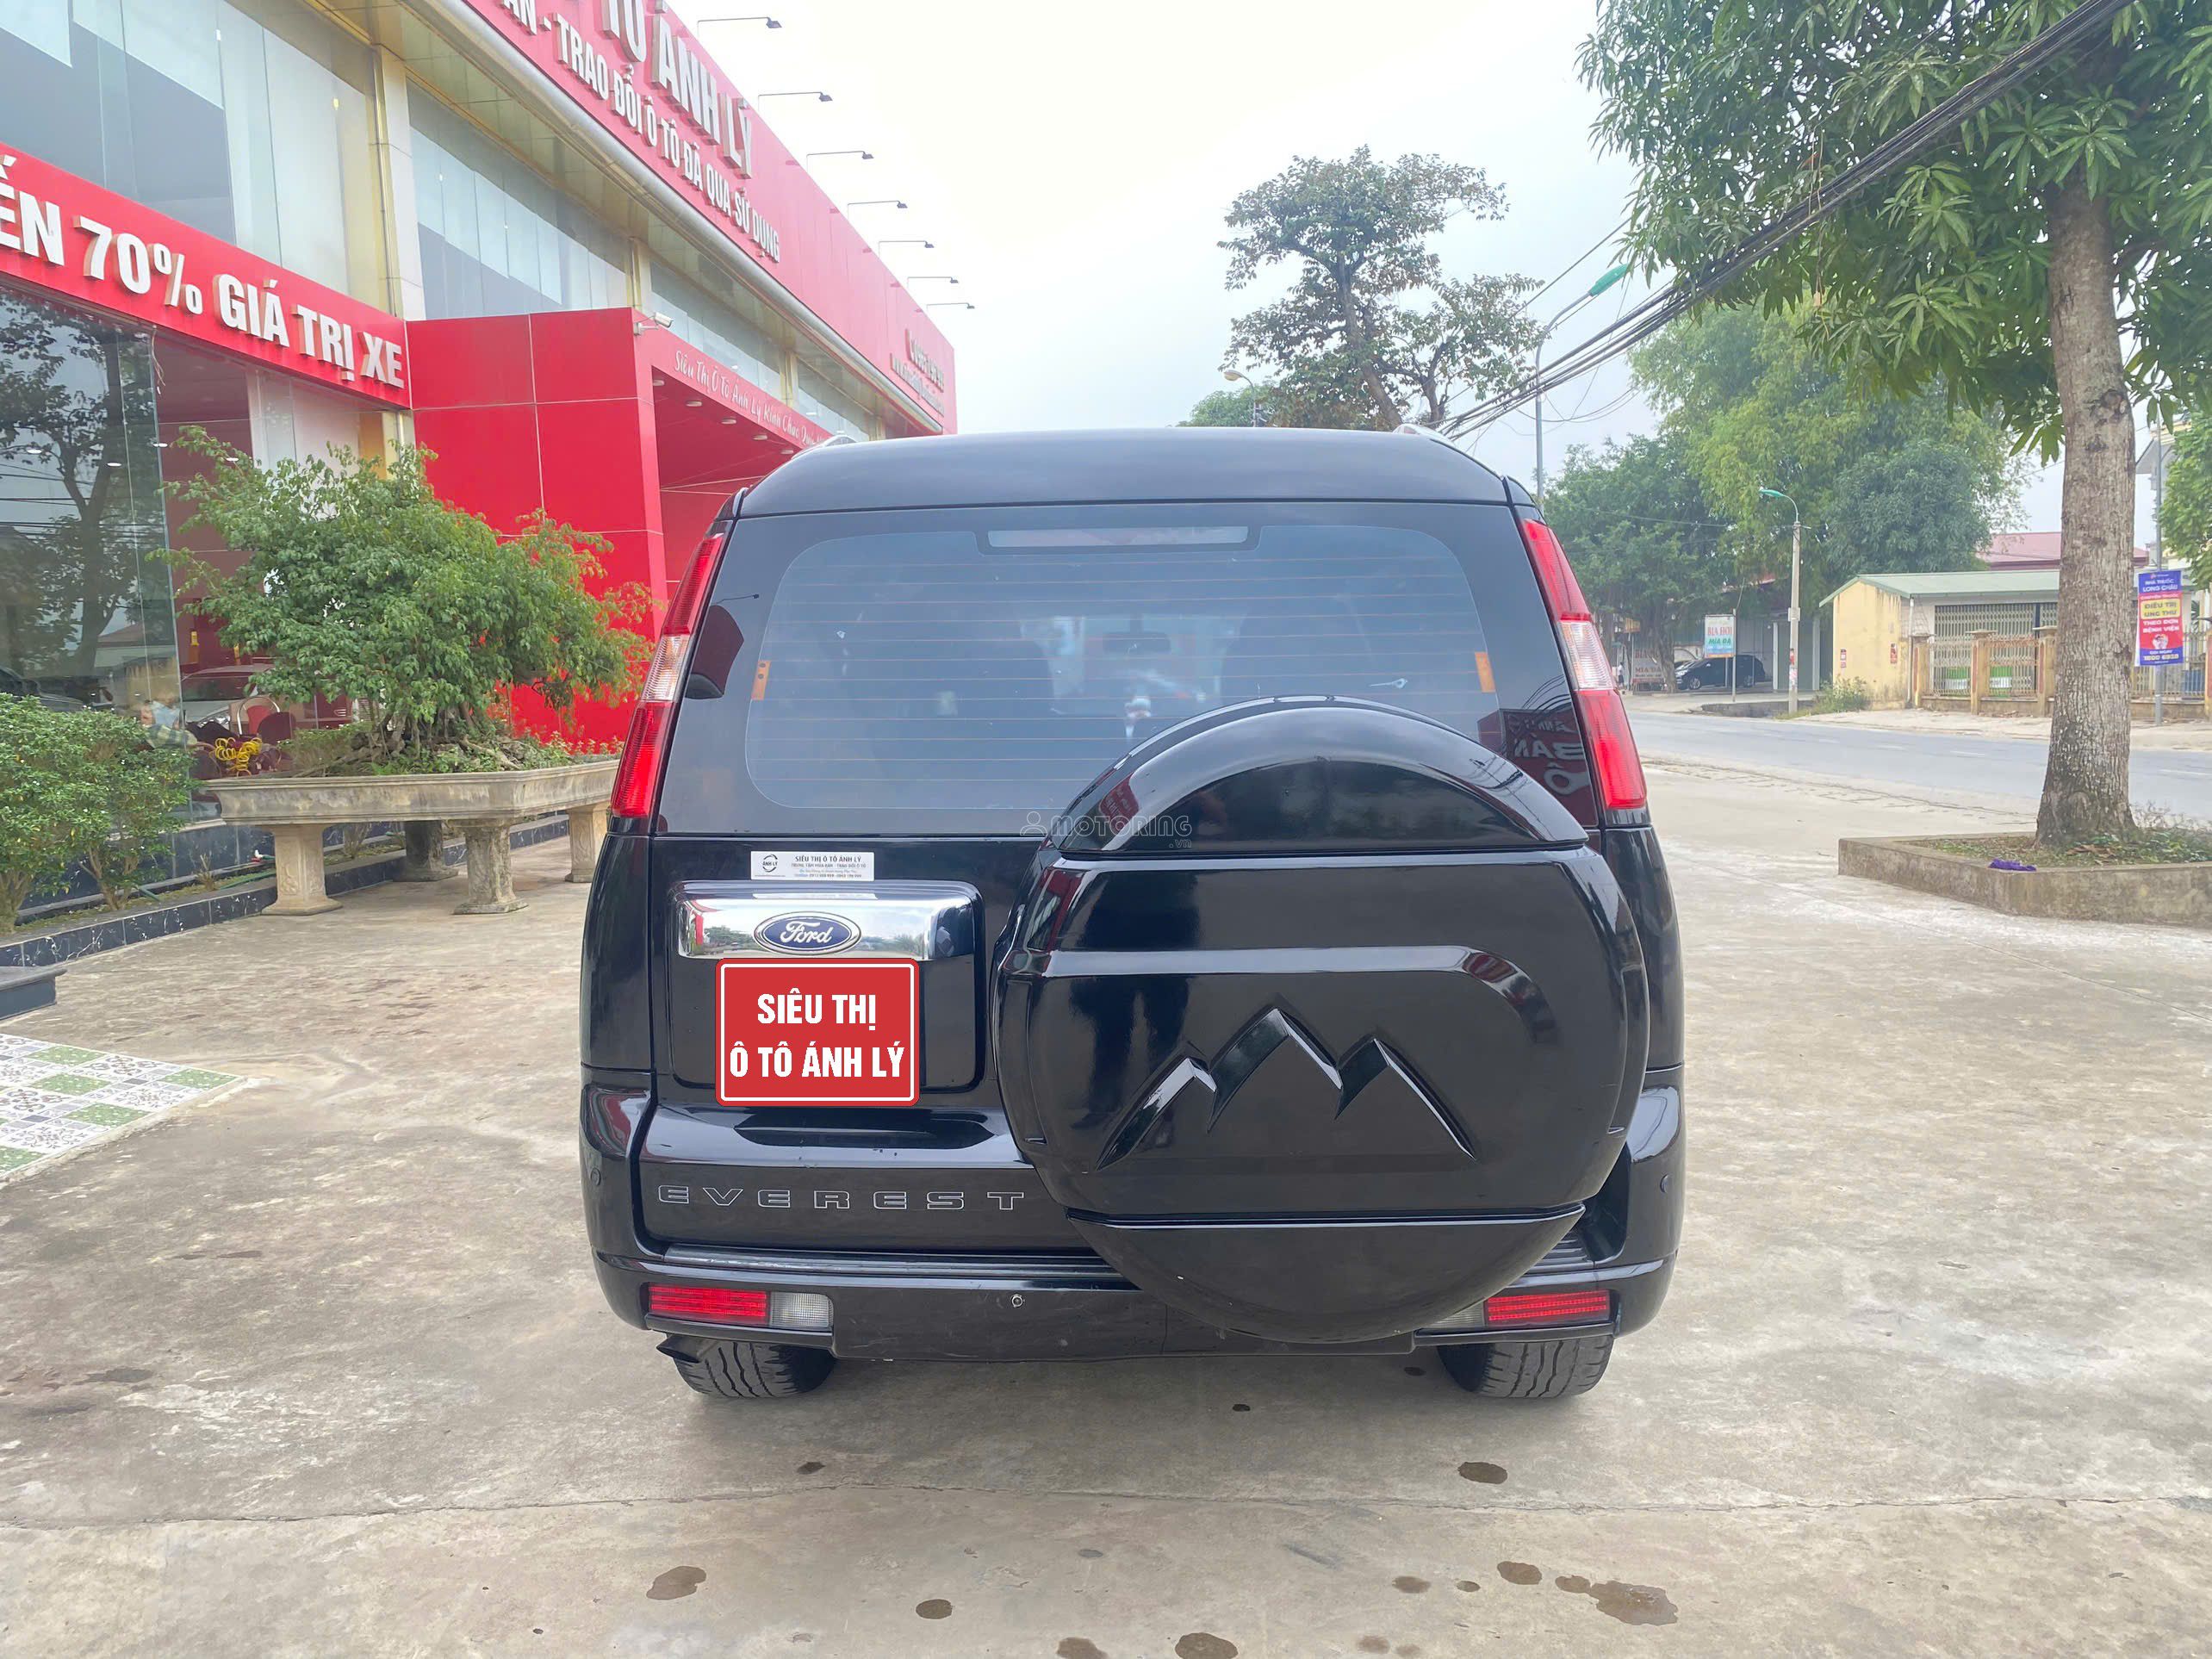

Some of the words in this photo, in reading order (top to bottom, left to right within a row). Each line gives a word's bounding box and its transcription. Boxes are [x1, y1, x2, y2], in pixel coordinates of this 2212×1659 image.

[554, 12, 609, 101] TRAO
[611, 63, 643, 135] ĐỔI
[643, 96, 657, 147] Ô
[657, 117, 680, 168] TÔ
[705, 163, 731, 218] QUA
[750, 207, 780, 263] DỤNG
[652, 0, 720, 146] ÁNH
[720, 95, 752, 179] LÝ
[73, 214, 204, 315] 70%
[213, 273, 290, 347] GIÁ
[291, 303, 355, 382] TRỊ
[357, 330, 405, 389] XE
[674, 351, 694, 379] Siêu
[696, 360, 711, 395] Thị
[730, 377, 749, 408] Ánh
[780, 921, 833, 945] Ford
[657, 1184, 1025, 1211] EVEREST
